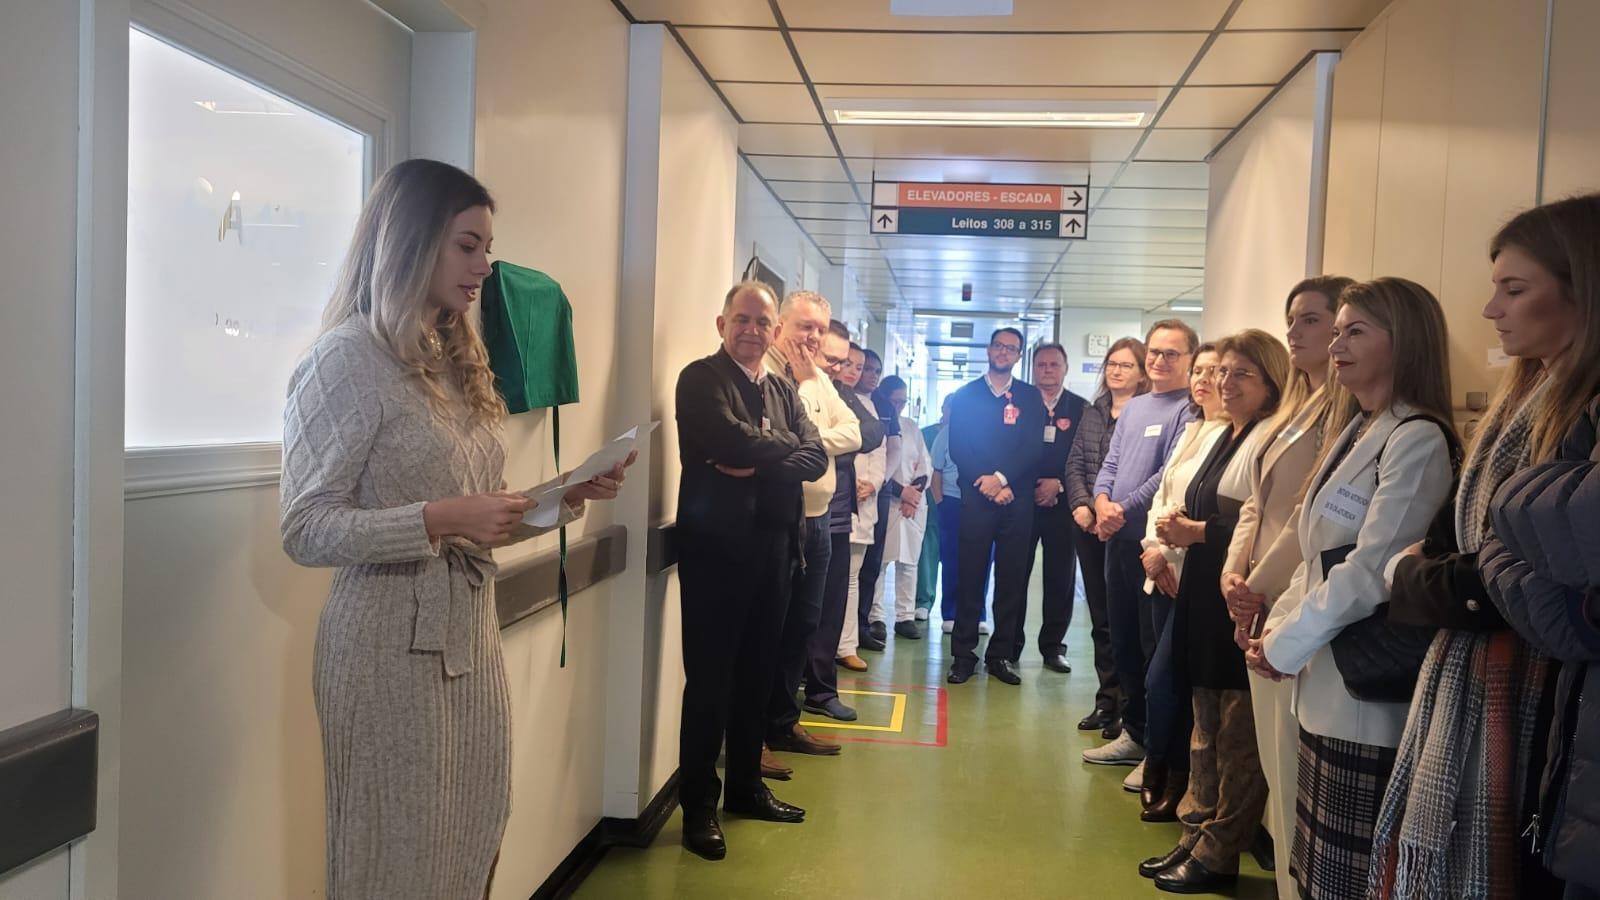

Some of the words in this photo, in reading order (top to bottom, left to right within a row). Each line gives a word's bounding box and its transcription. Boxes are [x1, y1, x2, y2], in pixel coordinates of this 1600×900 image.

[907, 190, 990, 203] ELEVADORES
[1000, 191, 1053, 204] ESCADA
[951, 217, 988, 229] Leitos
[993, 218, 1014, 230] 308
[1018, 221, 1026, 230] a
[1030, 219, 1052, 231] 315
